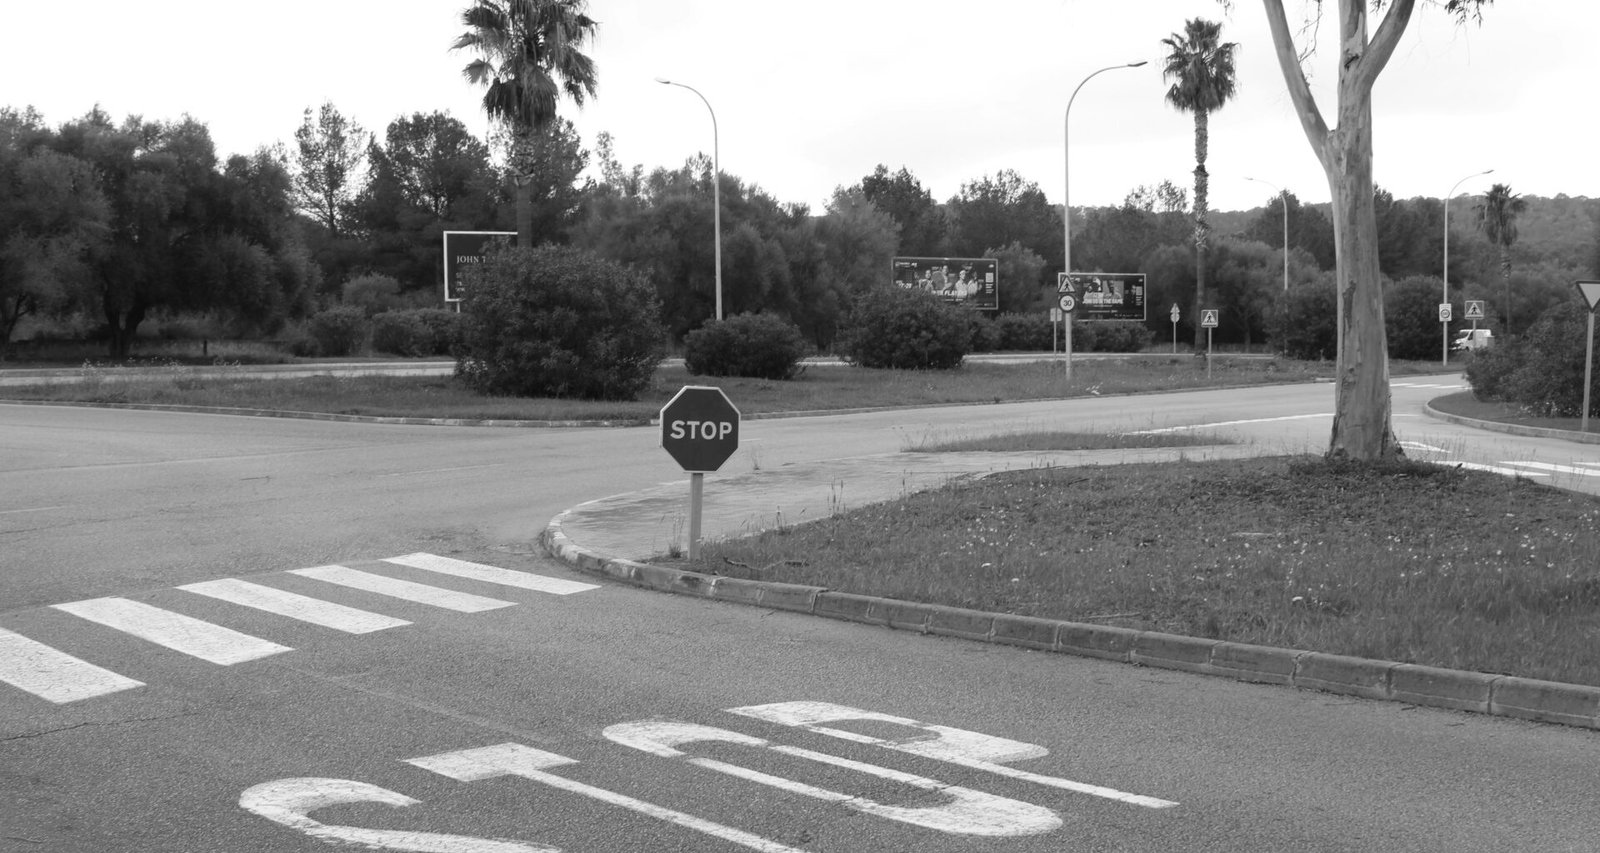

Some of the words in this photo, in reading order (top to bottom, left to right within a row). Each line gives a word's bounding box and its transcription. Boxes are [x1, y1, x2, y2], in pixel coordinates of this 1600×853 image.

[456, 255, 479, 264] JOHN
[1063, 299, 1072, 307] 30
[670, 419, 733, 440] STOP
